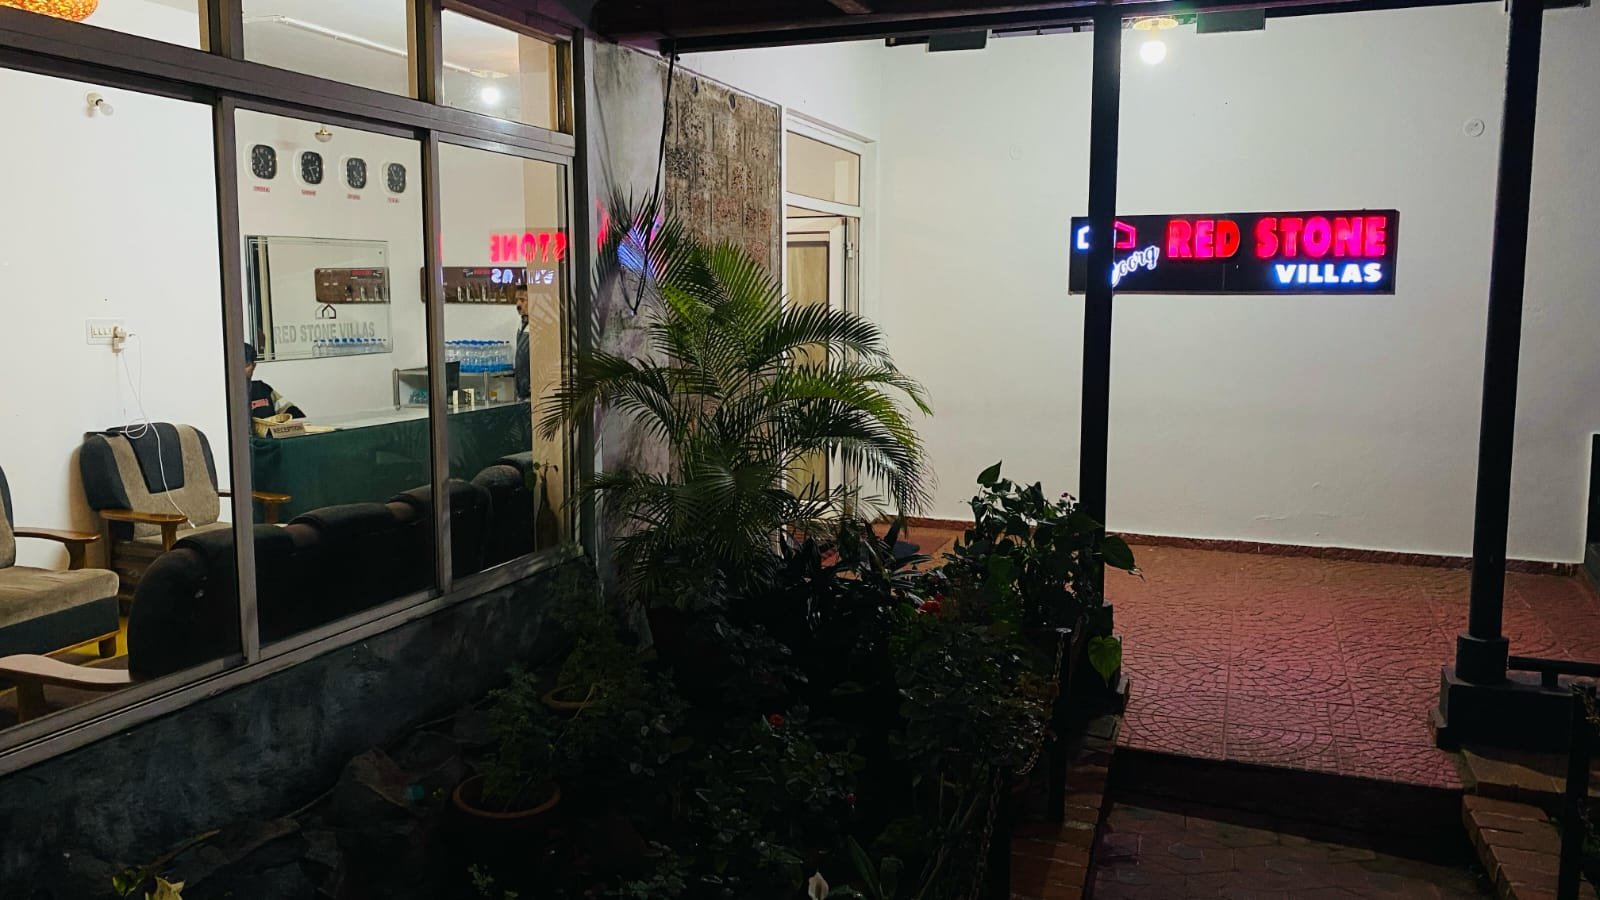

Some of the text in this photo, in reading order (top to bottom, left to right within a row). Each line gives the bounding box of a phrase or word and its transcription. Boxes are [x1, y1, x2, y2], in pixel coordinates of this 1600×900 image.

[1167, 216, 1387, 259] RED STONE
[1275, 262, 1383, 285] VILLAS
[274, 321, 375, 344] RED STONE VILLAS
